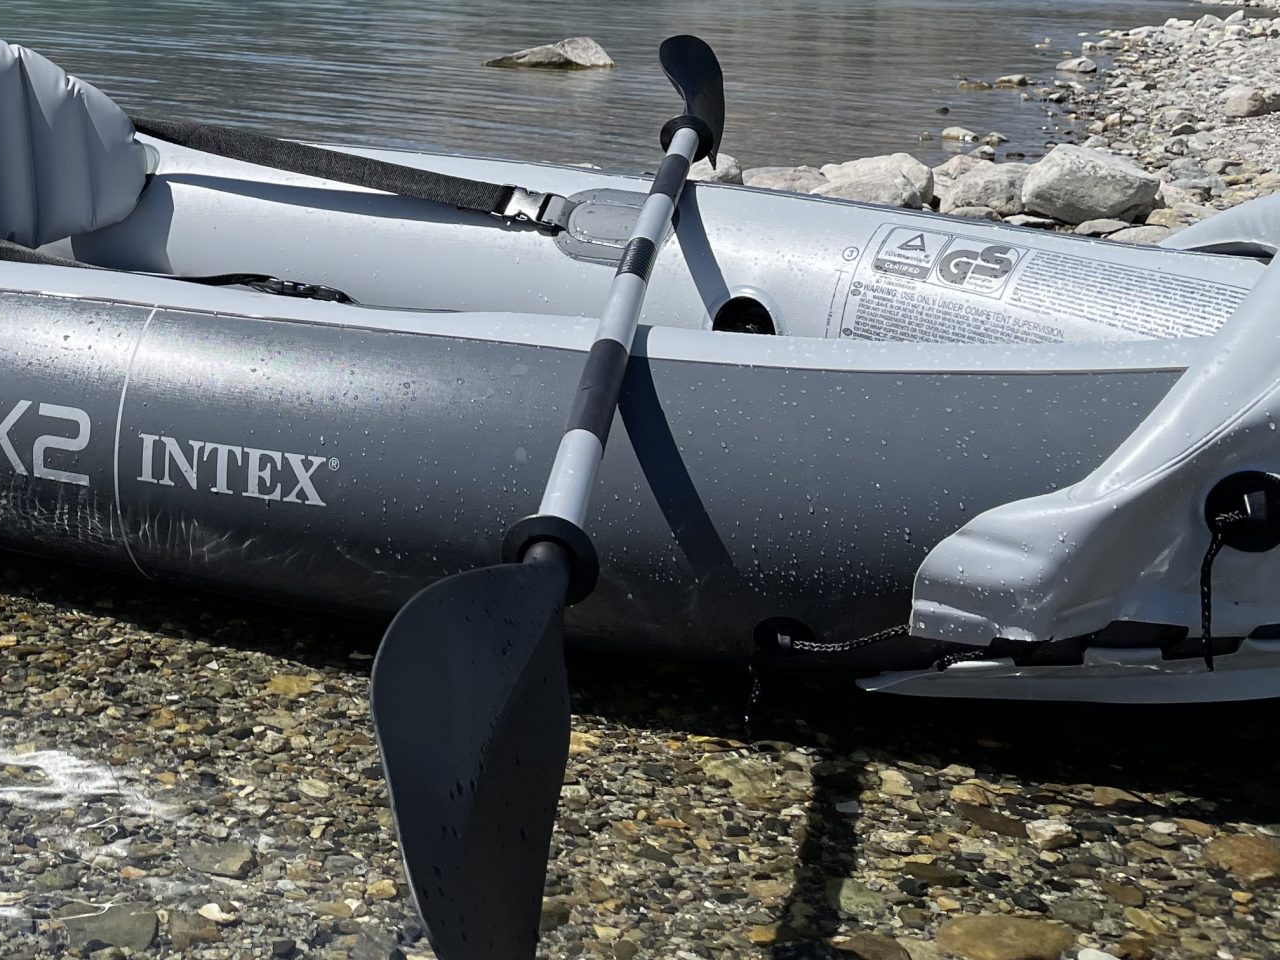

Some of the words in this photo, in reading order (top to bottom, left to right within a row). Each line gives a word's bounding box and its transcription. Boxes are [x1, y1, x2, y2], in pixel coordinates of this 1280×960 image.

[884, 262, 920, 274] CERTIFIED
[939, 245, 1013, 286] GS
[916, 294, 936, 307] ONLY
[937, 300, 963, 313] UNDER
[964, 305, 1011, 324] COMPETENT
